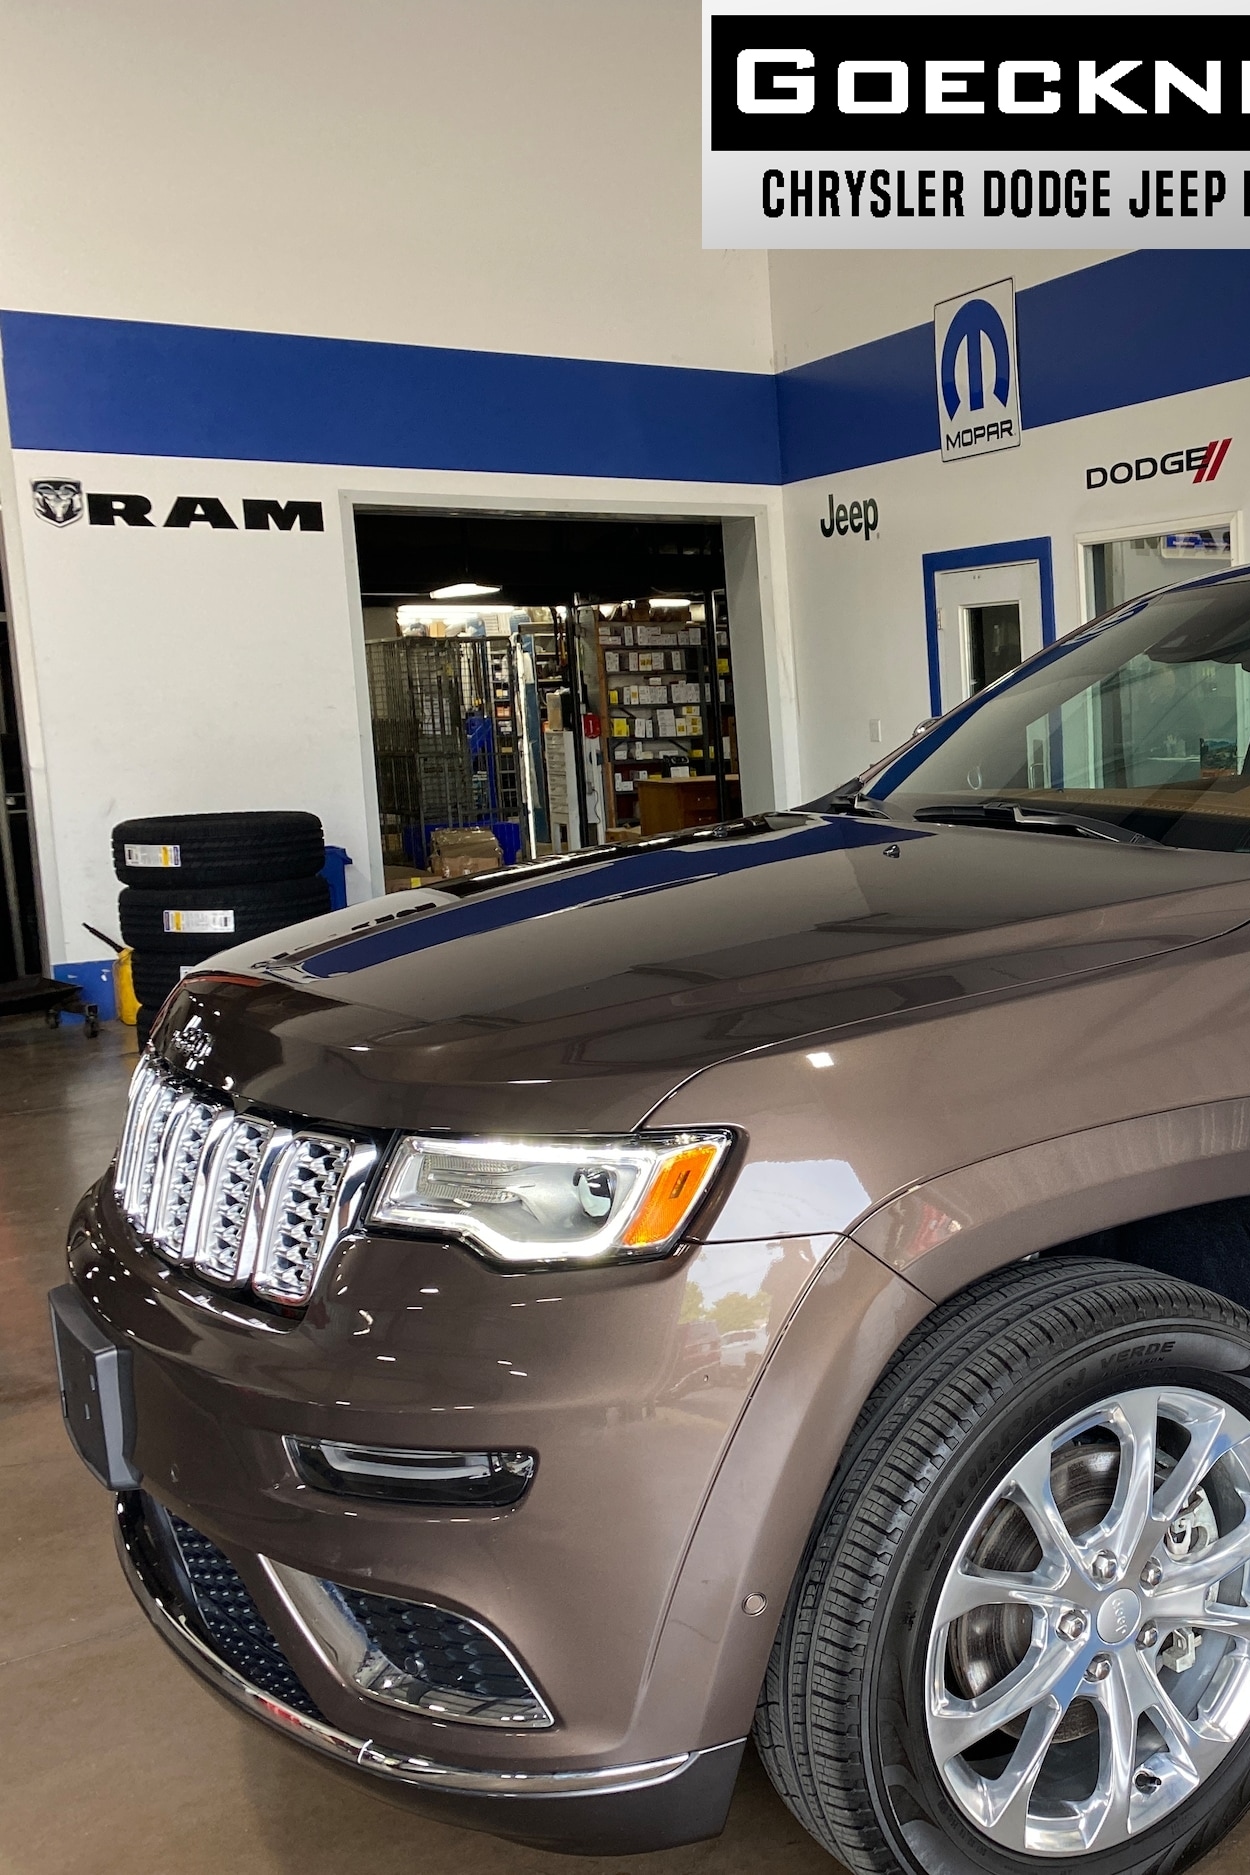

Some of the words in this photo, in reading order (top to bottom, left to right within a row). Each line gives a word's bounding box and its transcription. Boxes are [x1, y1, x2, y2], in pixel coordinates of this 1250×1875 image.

[945, 418, 1016, 452] MOPAR
[1085, 445, 1210, 490] DODGE
[86, 492, 326, 532] RAM
[820, 493, 880, 541] Jeep
[1101, 1340, 1176, 1369] VERDE
